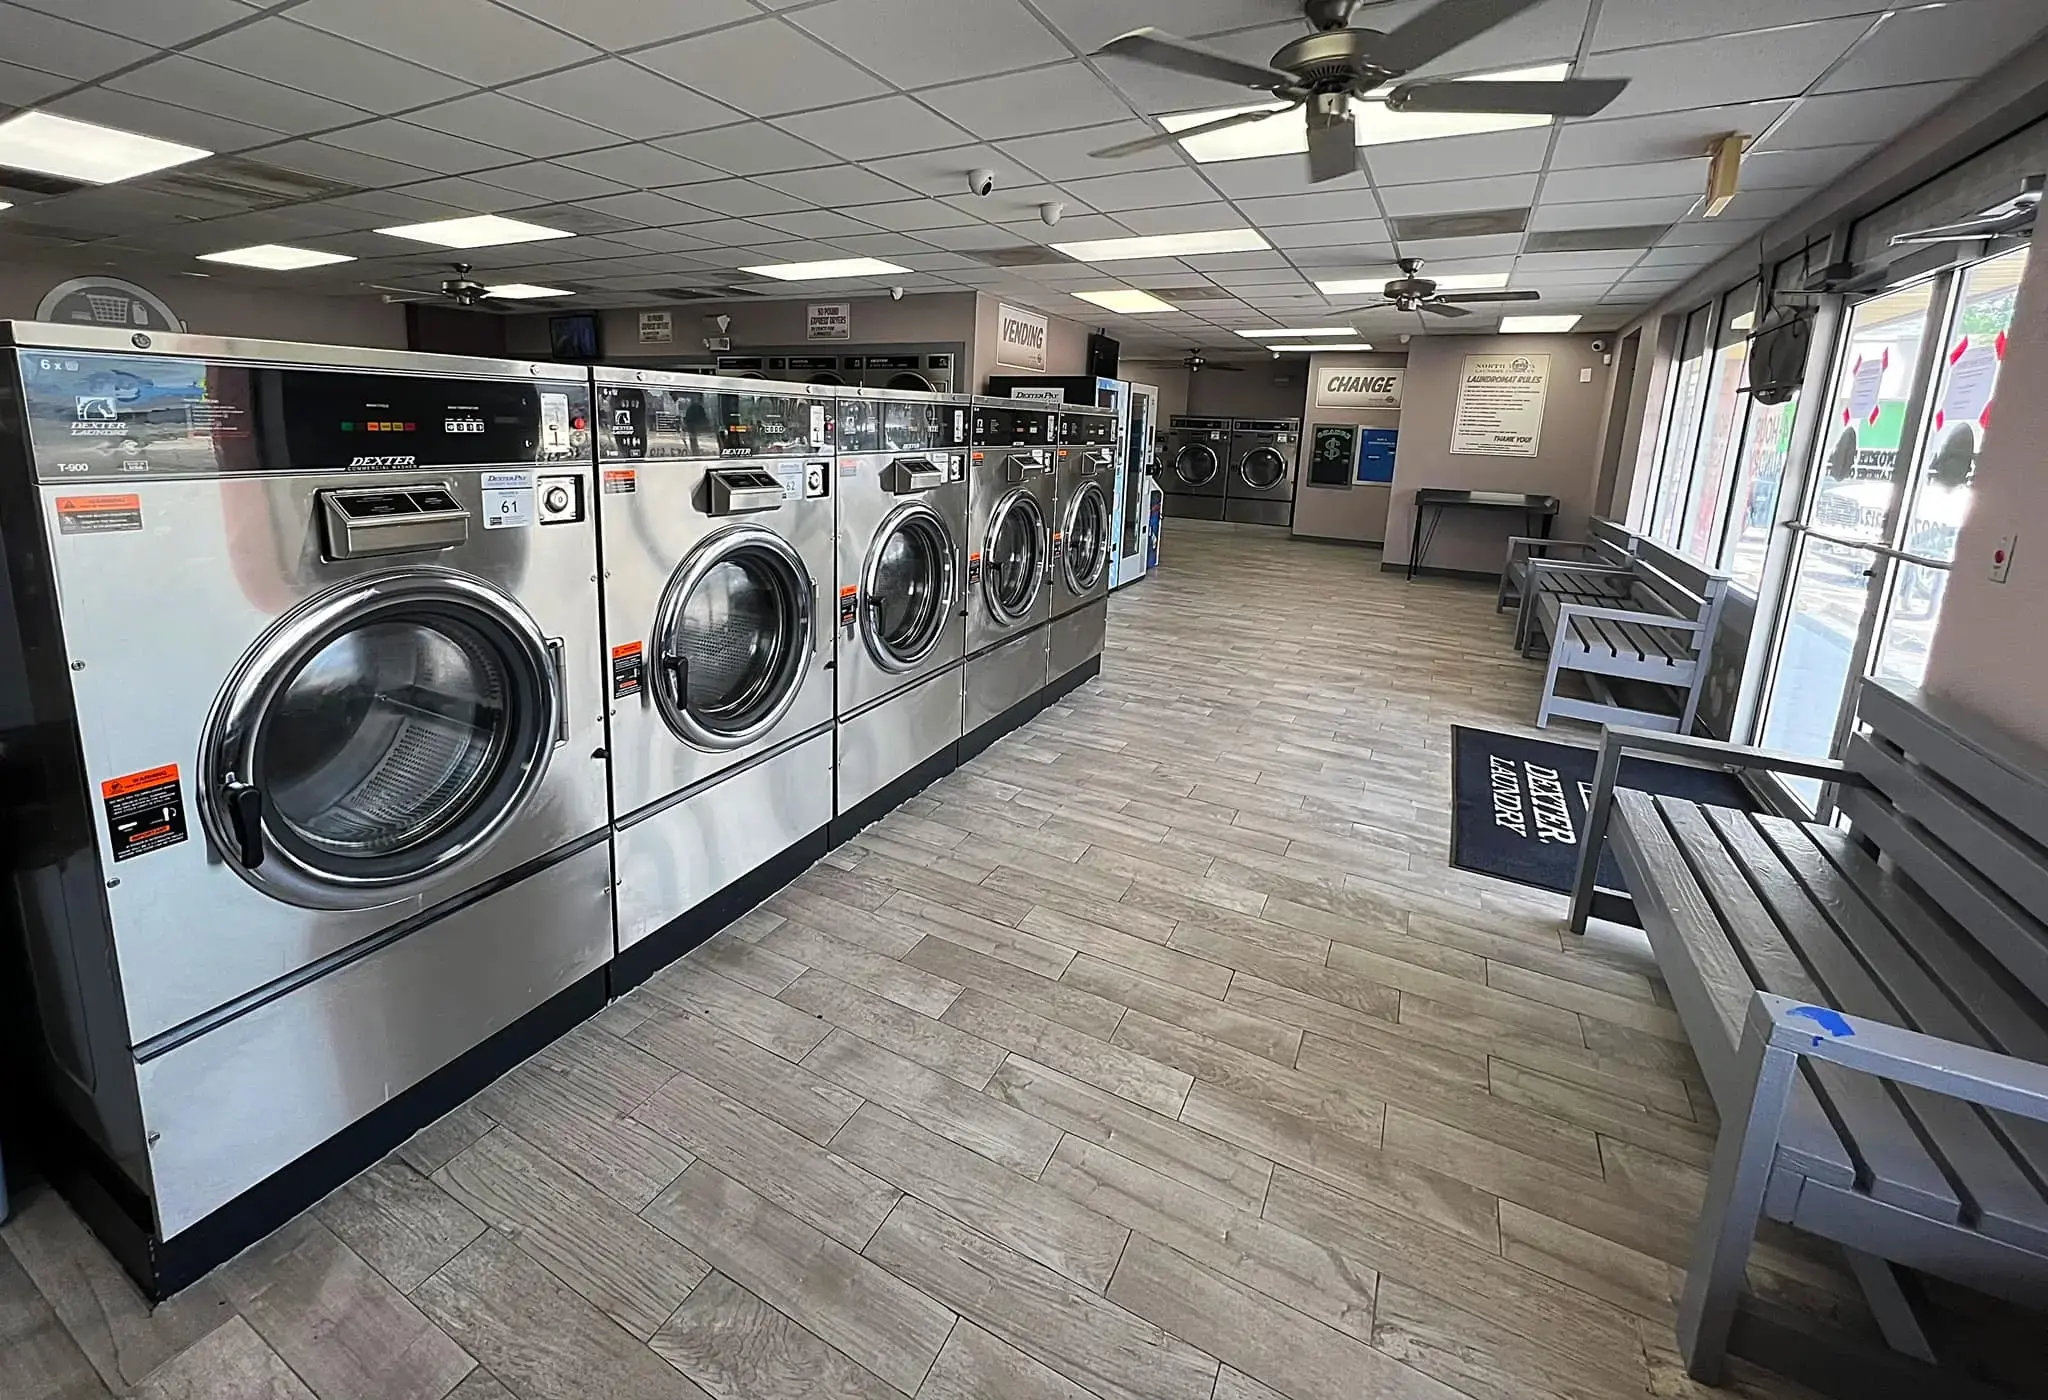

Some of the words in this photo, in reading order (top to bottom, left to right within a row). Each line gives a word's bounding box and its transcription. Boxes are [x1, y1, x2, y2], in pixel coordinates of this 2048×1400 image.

[1003, 318, 1043, 348] VENDING
[40, 360, 50, 370] 6
[1327, 376, 1396, 392] CHANGE
[57, 463, 88, 472] T-900
[350, 456, 416, 466] DEXTER
[786, 481, 795, 491] 62
[501, 500, 517, 513] 61
[1490, 754, 1527, 838] LAUNDRY
[1524, 761, 1576, 844] DEXTER
